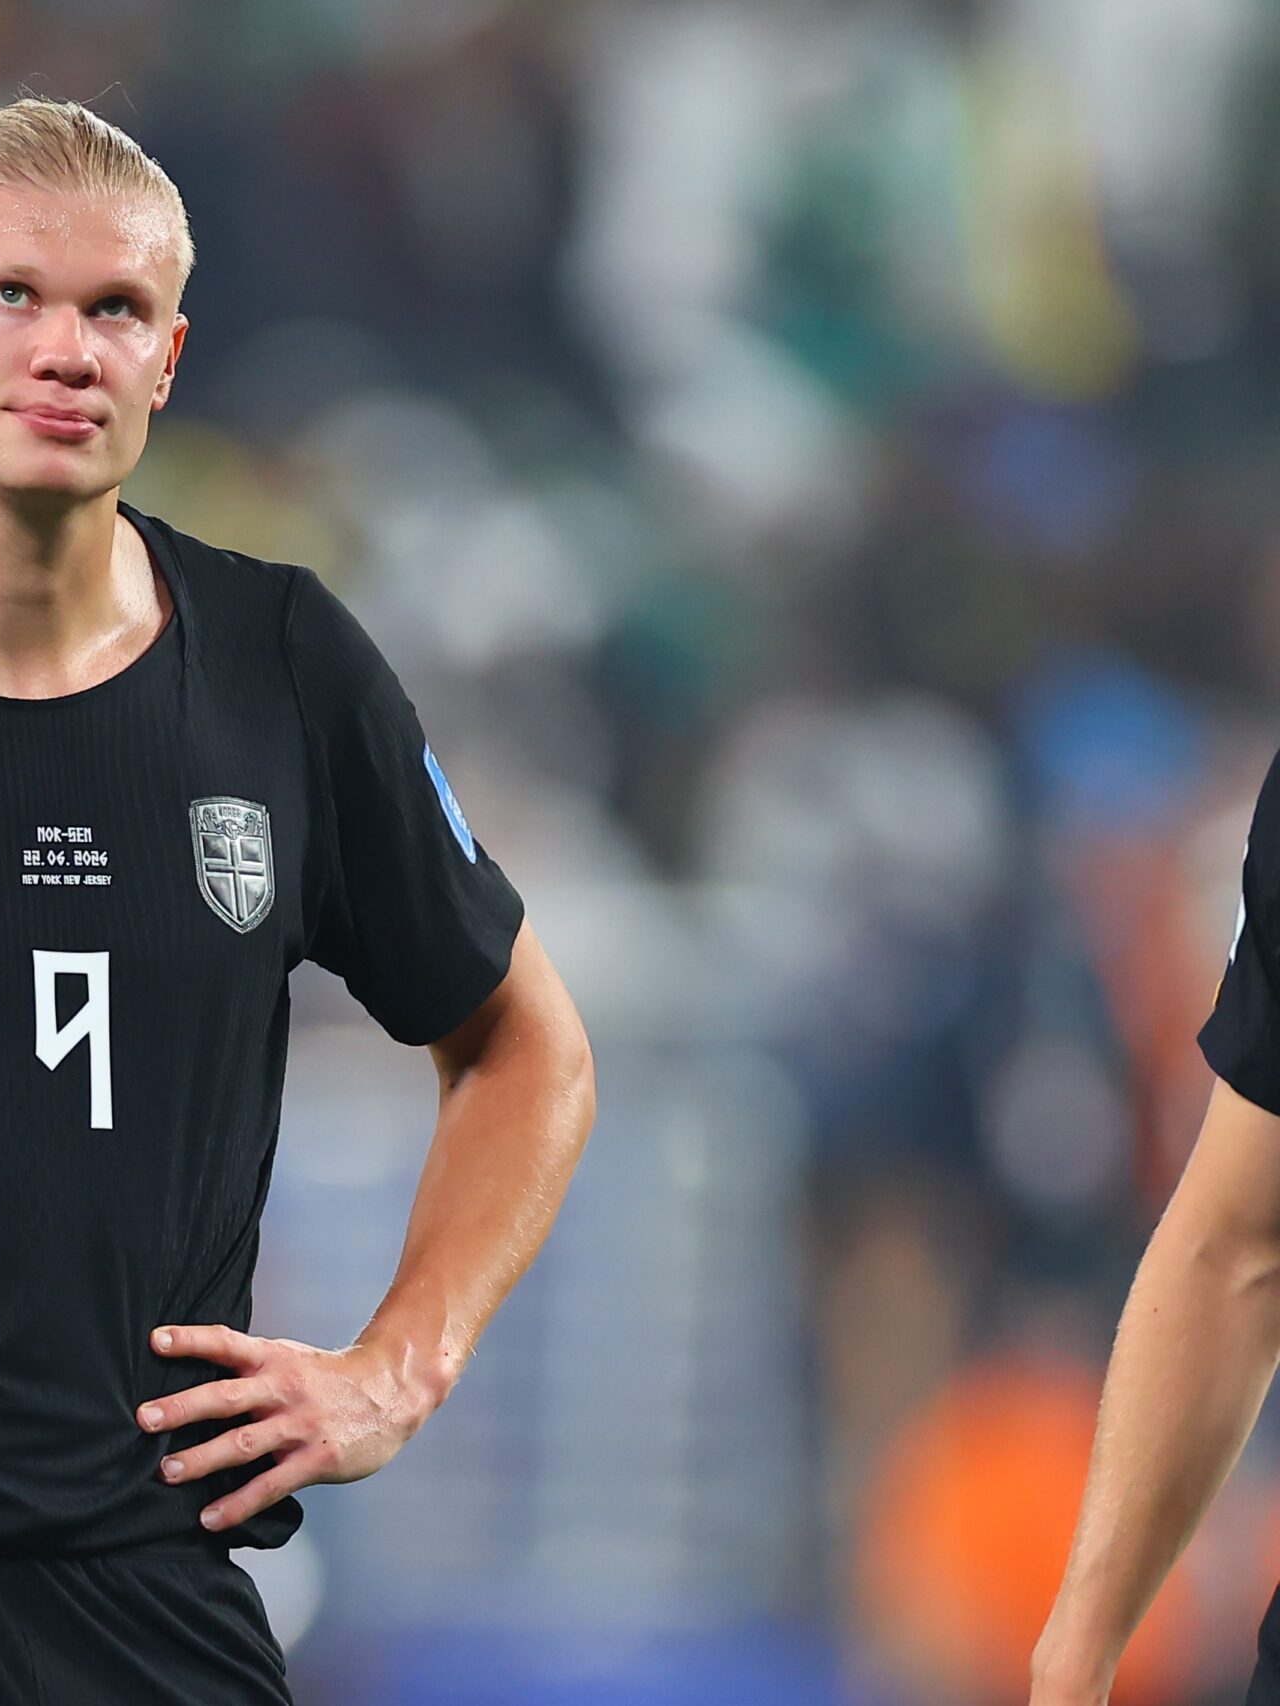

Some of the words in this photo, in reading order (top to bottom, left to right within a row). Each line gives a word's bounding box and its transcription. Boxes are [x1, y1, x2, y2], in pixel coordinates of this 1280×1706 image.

[37, 826, 92, 842] NOR-SEN
[22, 874, 40, 885] NEW
[41, 874, 62, 885] YORK
[63, 874, 81, 885] NEW
[82, 874, 112, 885] JERSEY
[32, 949, 113, 1129] 9
